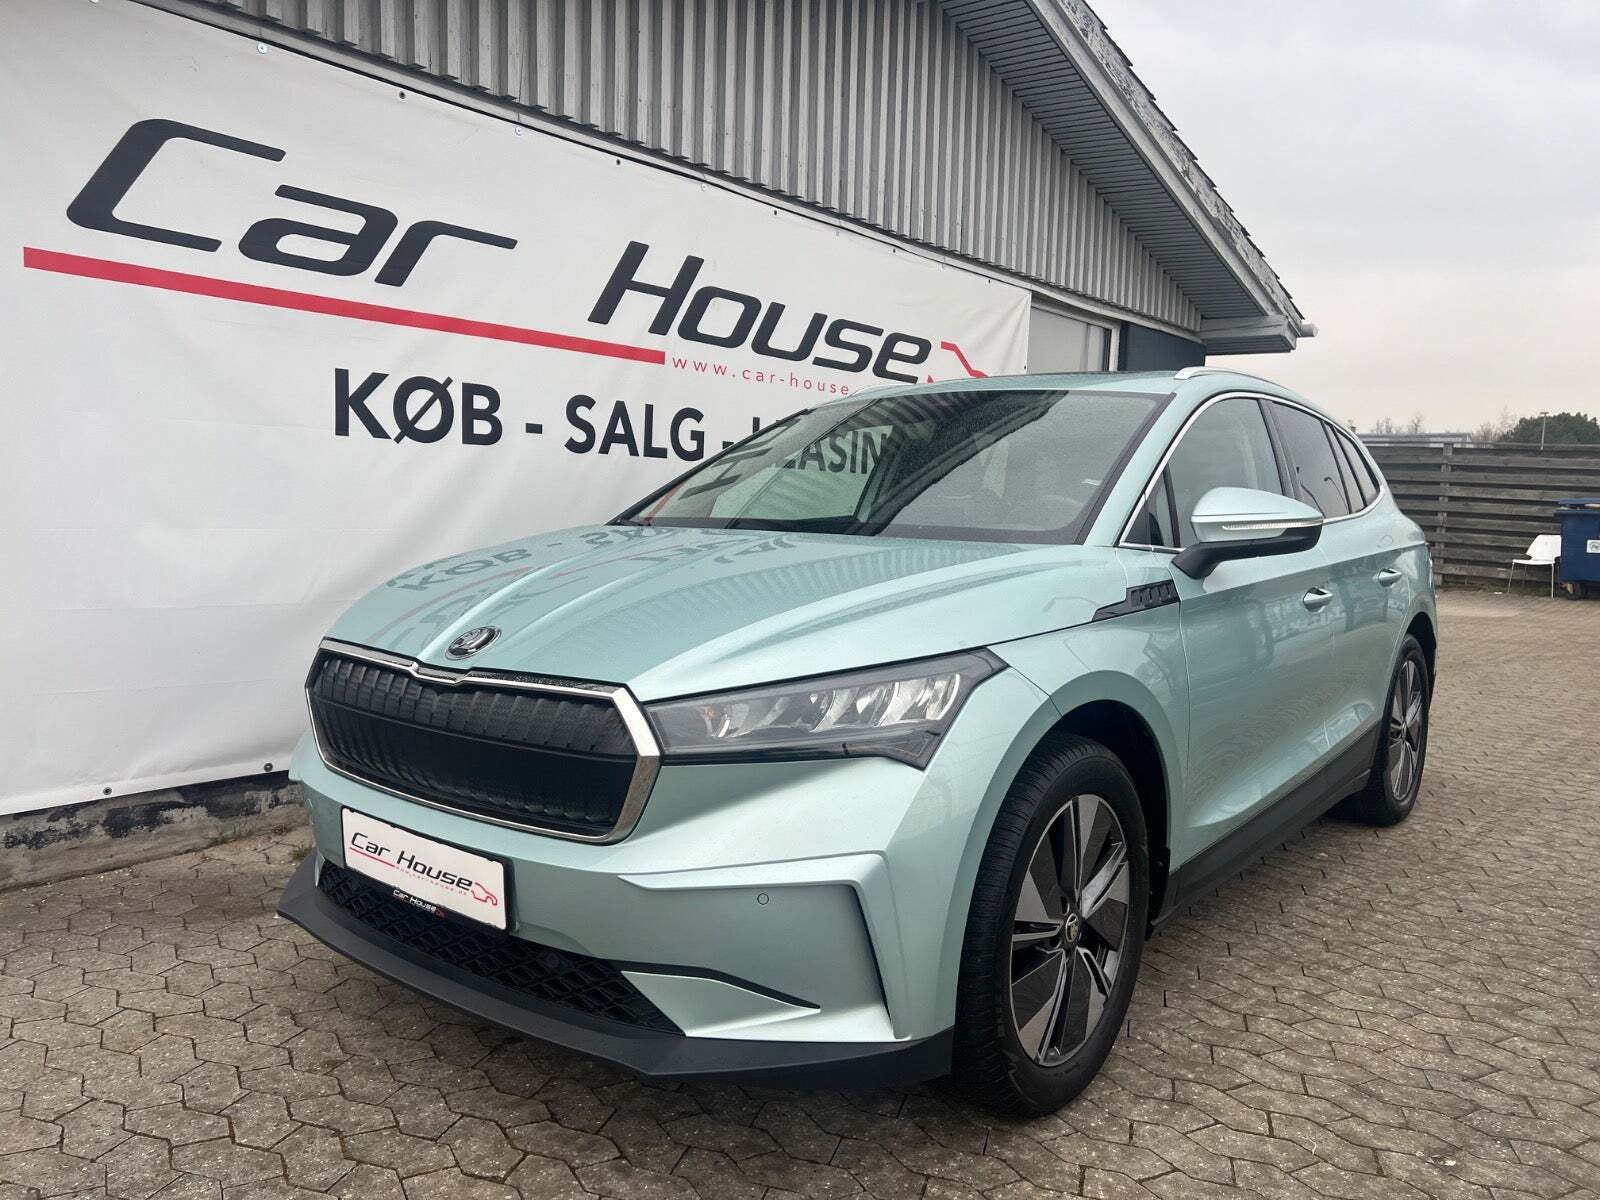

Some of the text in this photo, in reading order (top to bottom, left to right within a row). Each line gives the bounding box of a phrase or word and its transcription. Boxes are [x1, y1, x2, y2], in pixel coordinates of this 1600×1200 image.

[65, 118, 932, 385] Car House
[671, 356, 850, 396] www.car-house
[333, 368, 502, 446] KØB
[564, 394, 706, 463] SALG
[351, 832, 391, 857] Car
[396, 850, 473, 891] House
